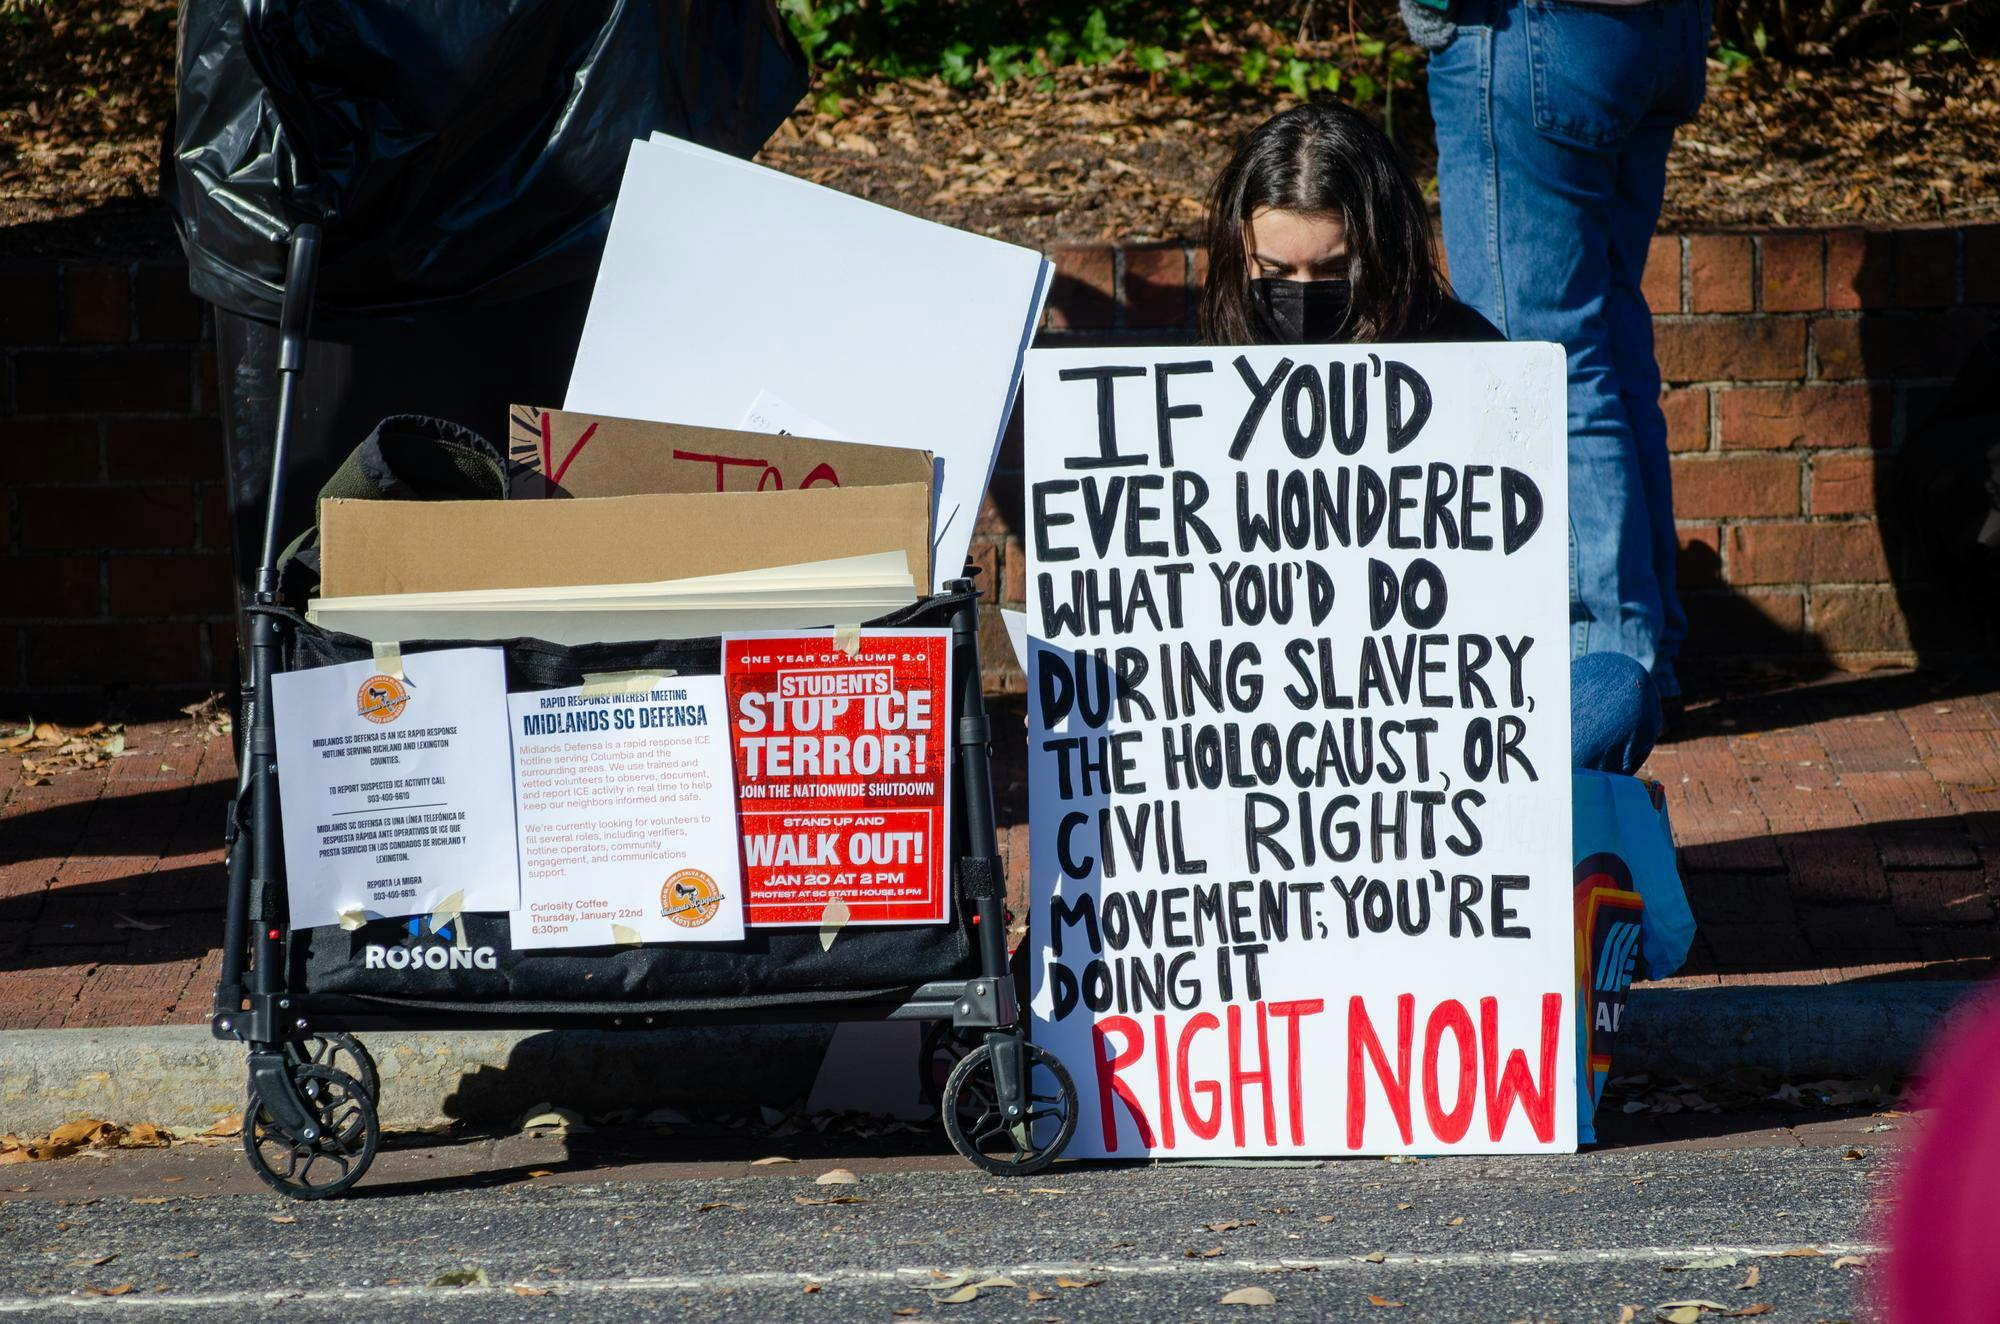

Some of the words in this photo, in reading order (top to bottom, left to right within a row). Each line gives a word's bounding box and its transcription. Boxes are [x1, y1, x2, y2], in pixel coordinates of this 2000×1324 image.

[1059, 361, 1213, 468] IF
[1228, 353, 1432, 461] YOU'D
[1032, 470, 1222, 562] EVER
[1236, 462, 1543, 555] WONDERED
[1038, 563, 1194, 639] WHAT
[1210, 560, 1335, 627] YOU'D
[1368, 557, 1448, 631] DO
[741, 655, 770, 663] ONE
[777, 655, 814, 663] YEAR
[820, 655, 838, 663] OF
[845, 654, 895, 662] TRUMP
[902, 654, 926, 662] 2.0
[782, 673, 887, 696] STUDENTS
[1038, 639, 1264, 730] DURING
[1284, 634, 1535, 713] SLAVERY,
[540, 697, 566, 709] RAPID
[651, 690, 686, 702] MEETING
[739, 692, 848, 732] STOP
[864, 690, 931, 730] ICE
[523, 712, 609, 735] MIDLANDS
[613, 710, 634, 730] SC
[639, 706, 707, 728] DEFENSA
[313, 737, 344, 747] MIDLANDS
[343, 736, 353, 745] SC
[353, 734, 379, 744] DEFENSA
[379, 733, 386, 741] IS
[387, 732, 396, 741] AN
[396, 731, 406, 740] ICE
[407, 730, 425, 739] RAPID
[426, 727, 457, 737] RESPONSE
[520, 743, 563, 753] Midlands
[563, 741, 603, 751] Defensa
[604, 741, 613, 749] is
[623, 739, 646, 750] rapid
[649, 739, 692, 748] response
[694, 736, 710, 744] ICE
[322, 749, 345, 758] HOTLINE
[345, 746, 371, 756] SERVING
[372, 744, 402, 754] RICHLAND
[403, 743, 416, 752] AND
[416, 740, 448, 750] LEXINGTON
[521, 755, 553, 765] hotline
[553, 753, 590, 765] serving
[590, 750, 634, 760] Columbia
[636, 749, 653, 758] and
[656, 748, 671, 757] the
[740, 735, 926, 776] TERROR!
[1043, 731, 1146, 800] THE
[1464, 716, 1539, 785] OR
[370, 756, 400, 765] COUNTIES.
[522, 765, 577, 778] surrounding
[609, 763, 624, 771] We
[646, 760, 678, 769] trained
[681, 759, 698, 767] and
[329, 787, 337, 795] TO
[336, 785, 359, 794] REPORT
[360, 781, 393, 792] SUSPECTED
[393, 781, 403, 789] ICE
[404, 778, 430, 788] ACTIVITY
[431, 777, 445, 786] CALL
[522, 778, 553, 788] vetted
[553, 776, 603, 786] volunteers
[605, 775, 615, 783] to
[617, 773, 657, 784] observe,
[660, 770, 708, 781] document,
[523, 790, 541, 799] and
[540, 788, 572, 799] report
[572, 788, 589, 796] ICE
[591, 786, 624, 797] activity
[626, 785, 634, 793] in
[637, 784, 654, 792] real
[657, 783, 677, 791] time
[680, 782, 689, 790] to
[691, 781, 711, 791] help
[740, 785, 765, 798] JOIN
[769, 785, 790, 798] THE
[793, 783, 865, 797] NATIONWIDE
[869, 783, 933, 796] SHUTDOWN
[524, 801, 548, 811] keep
[566, 797, 613, 809] neighbors
[615, 795, 656, 805] informed
[659, 794, 676, 802] and
[679, 793, 700, 801] safe.
[317, 822, 347, 833] MIDLANDS
[347, 821, 356, 830] SC
[357, 819, 383, 829] DEFENSA
[383, 818, 391, 827] ES
[391, 817, 404, 826] UNA
[457, 812, 465, 820] DE
[525, 823, 554, 832] We're
[555, 821, 597, 832] currently
[598, 819, 632, 830] looking
[635, 818, 647, 826] for
[650, 815, 698, 825] volunteers
[701, 814, 710, 822] to
[783, 817, 831, 826] STAND
[833, 817, 852, 826] UP
[855, 817, 884, 826] AND
[526, 836, 538, 844] fill
[537, 834, 573, 843] several
[575, 832, 601, 842] roles,
[603, 830, 645, 842] including
[647, 828, 686, 839] verifiers,
[1057, 800, 1207, 880] CIVIL
[376, 853, 409, 863] LEXINGTON.
[743, 833, 840, 866] WALK
[848, 832, 923, 865] OUT!
[527, 855, 588, 867] engagement,
[591, 854, 608, 862] and
[610, 850, 686, 861] communications
[366, 879, 392, 888] REPORTA
[393, 878, 400, 886] LA
[401, 877, 421, 886] MIGRA
[764, 874, 801, 885] JAN
[804, 873, 830, 885] 20
[834, 873, 855, 885] AT
[860, 873, 872, 885] 2
[875, 873, 903, 885] PM
[751, 890, 796, 898] PROTEST
[827, 889, 858, 897] STATE
[859, 889, 895, 897] HOUSE,
[905, 888, 921, 896] PM
[530, 900, 573, 912] Curiosity
[575, 899, 608, 908] Coffee
[1050, 880, 1328, 957] MOVEMENT;
[1331, 870, 1530, 939] YOU'RE
[531, 911, 577, 923] Thursday,
[580, 909, 615, 921] January
[618, 908, 642, 917] 22nd
[532, 924, 568, 935] 6:30pm
[365, 944, 497, 971] ROSONG
[1049, 951, 1201, 1021] DOING
[1217, 943, 1268, 1002] IT
[1092, 999, 1324, 1152] RIGHT
[1346, 993, 1562, 1150] NOW
